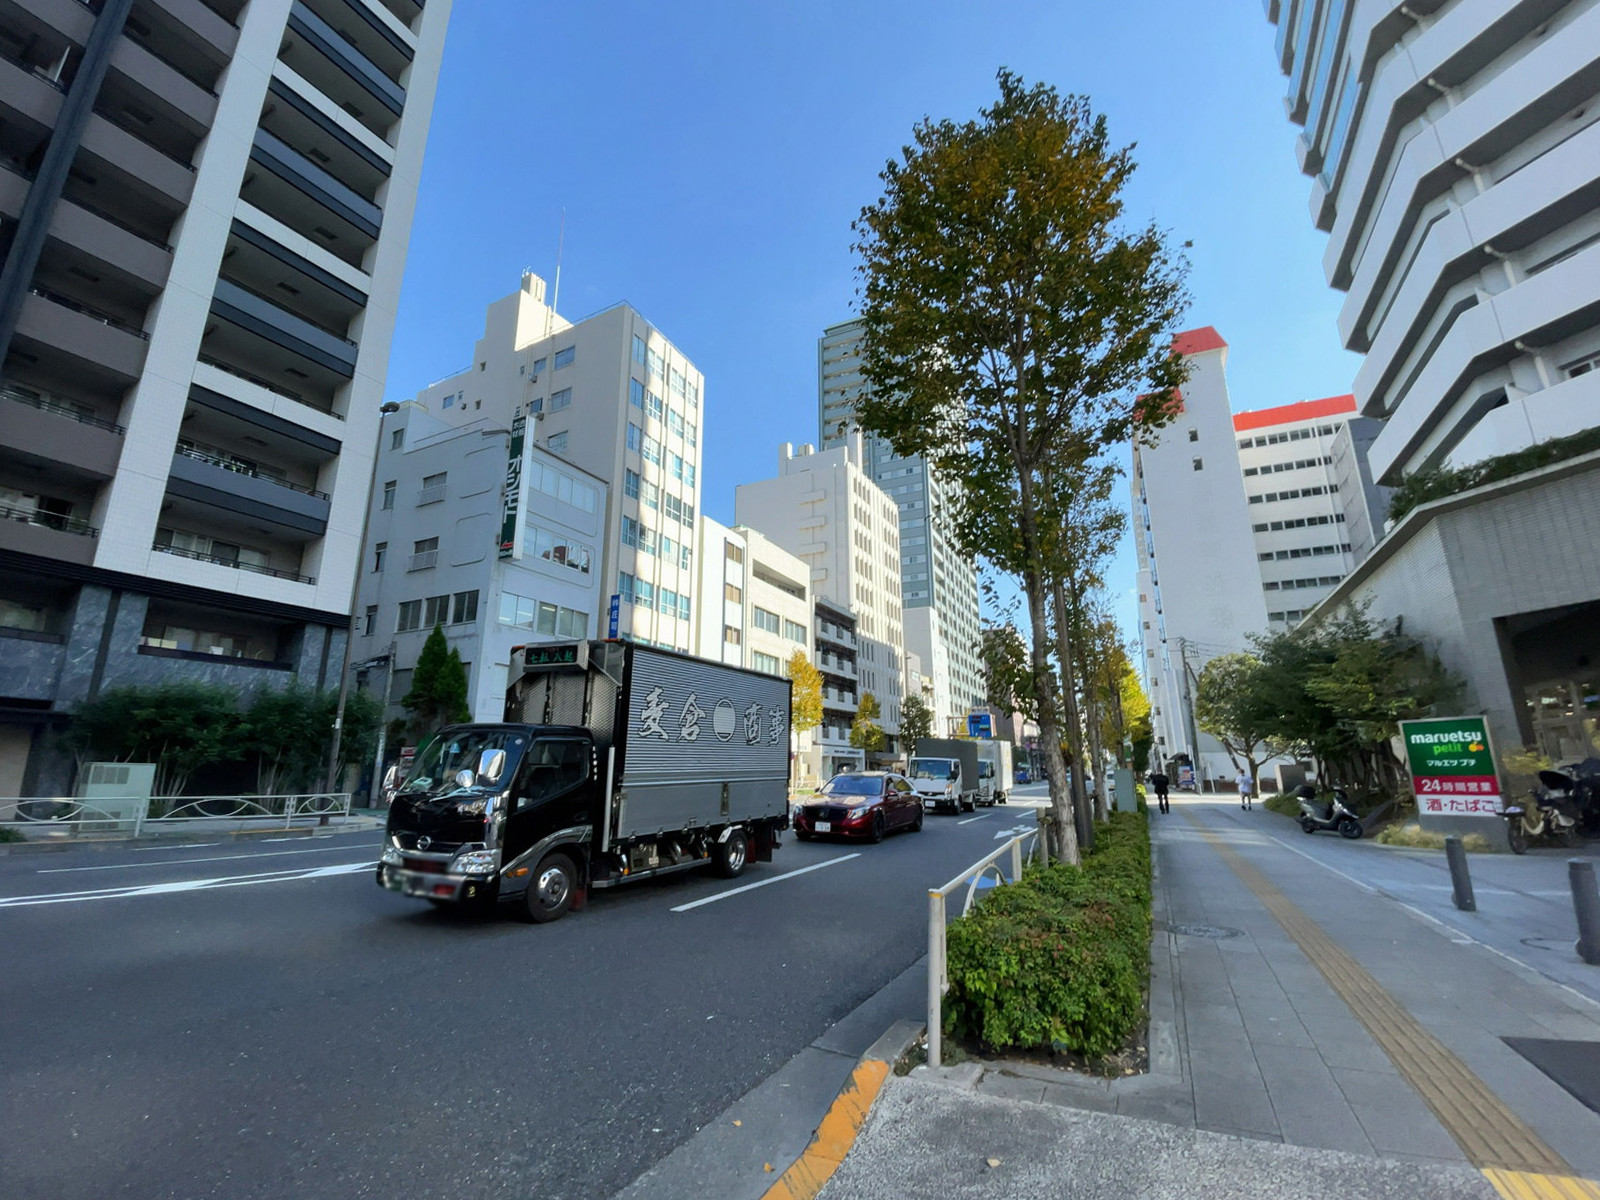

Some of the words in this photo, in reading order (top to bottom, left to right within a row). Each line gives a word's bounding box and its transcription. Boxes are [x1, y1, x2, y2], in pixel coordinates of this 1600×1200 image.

[503, 454, 523, 524] オシモト
[1410, 730, 1483, 744] maruetsu
[1433, 743, 1463, 756] petit
[1426, 759, 1458, 767] マルエツ
[1459, 758, 1477, 767] プチ
[1421, 779, 1492, 792] 24時間営業
